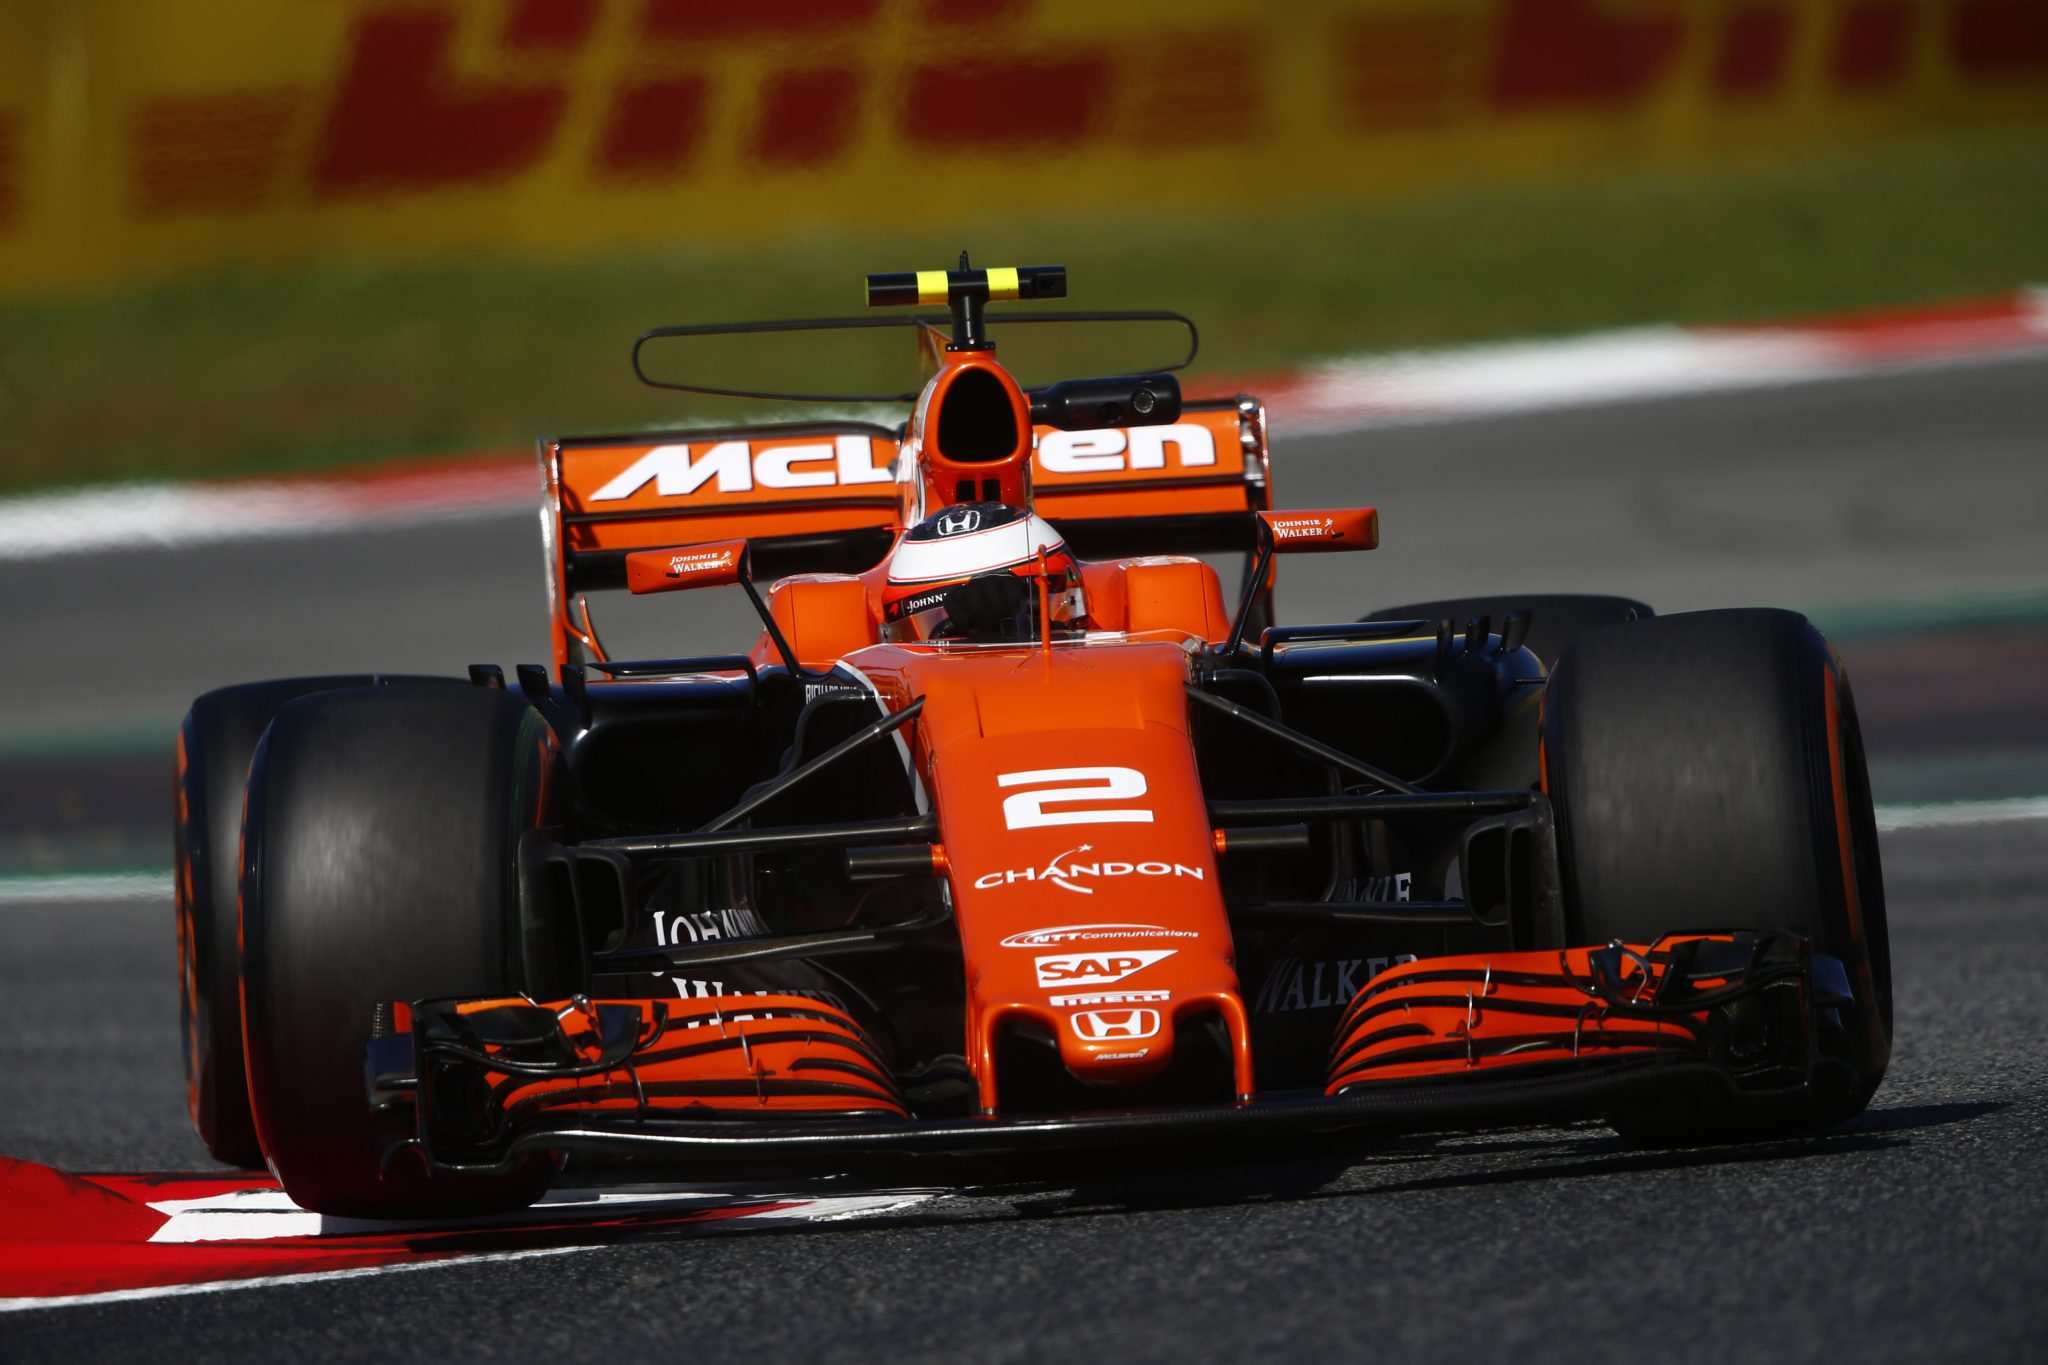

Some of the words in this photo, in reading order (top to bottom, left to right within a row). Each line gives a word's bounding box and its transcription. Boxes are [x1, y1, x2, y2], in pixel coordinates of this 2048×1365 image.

[1279, 527, 1323, 539] WALKER
[907, 592, 947, 613] JOHNN
[997, 766, 1155, 831] 2
[974, 860, 1205, 890] CHANDON
[1032, 932, 1082, 943] NTT
[1039, 957, 1143, 981] SAP
[1049, 989, 1171, 1008] PIRELLI
